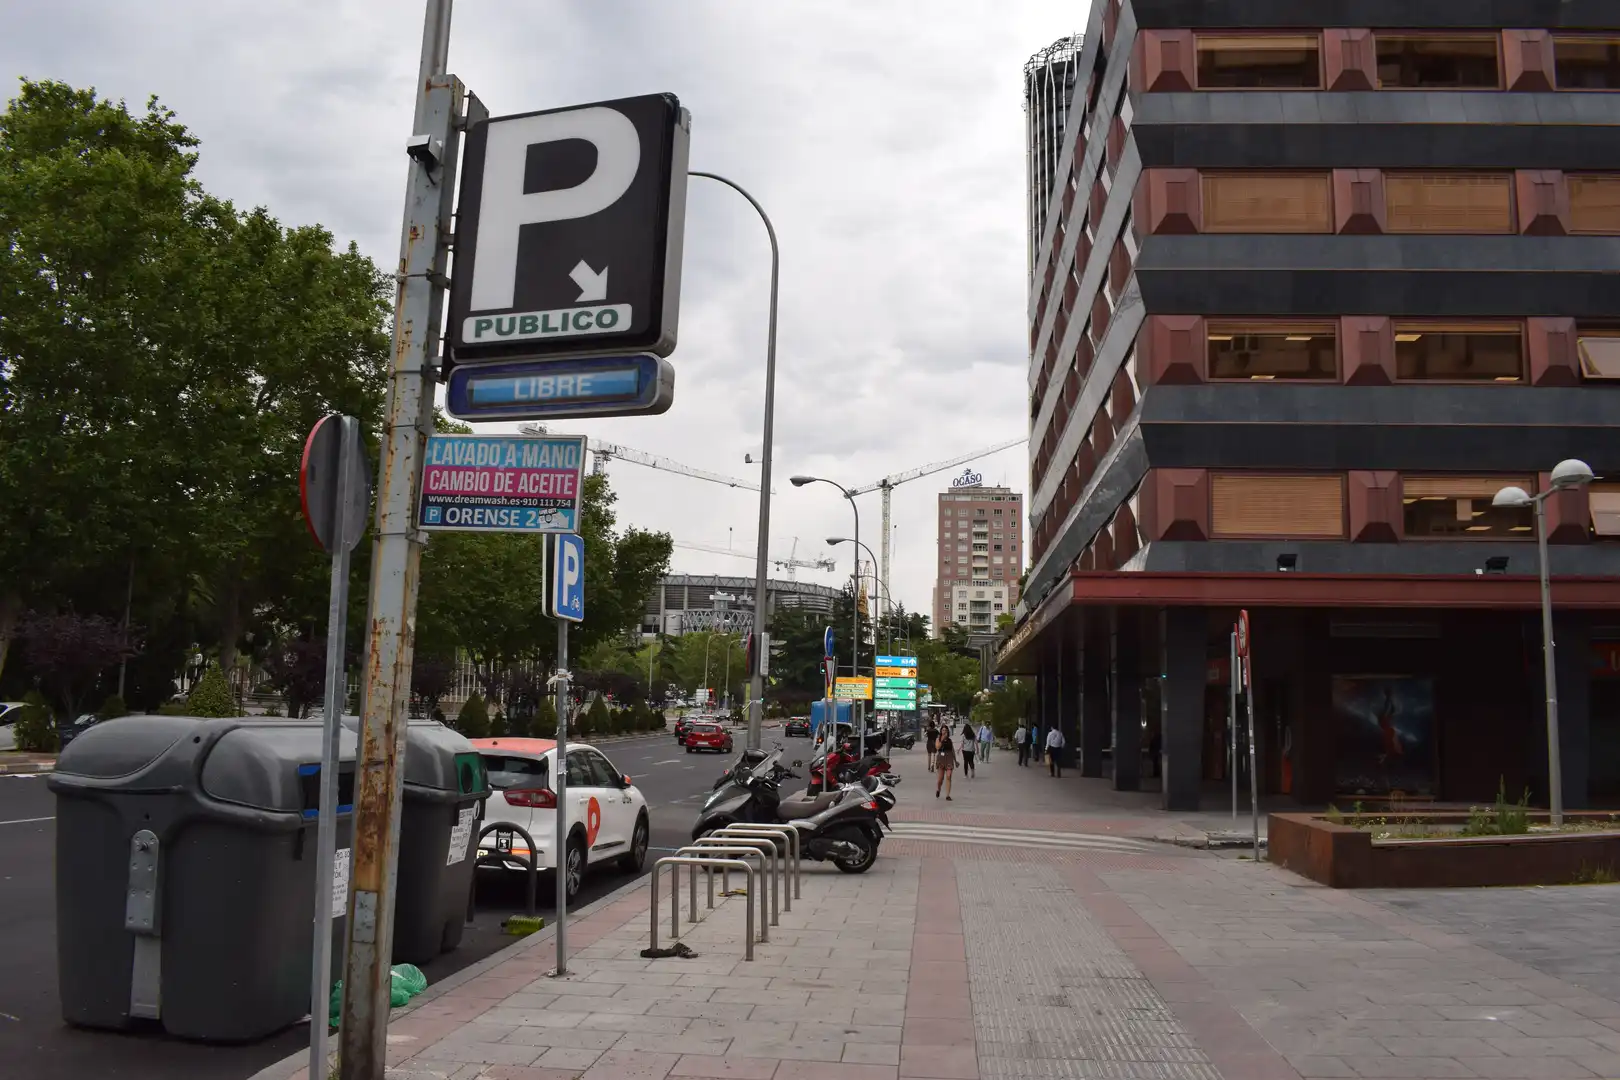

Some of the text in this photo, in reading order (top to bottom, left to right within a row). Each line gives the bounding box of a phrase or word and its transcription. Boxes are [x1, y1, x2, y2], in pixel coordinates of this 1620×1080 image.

[470, 106, 641, 311] P
[474, 308, 619, 338] PUBLICO
[514, 374, 595, 400] LIBRE
[431, 441, 577, 469] LAVADO A MANO
[429, 469, 574, 495] CAMBIO DE ACEITE
[953, 473, 982, 487] OCASO
[539, 498, 554, 507] 111
[556, 499, 571, 508] 754
[445, 507, 520, 527] ORENSE
[563, 540, 579, 606] P
